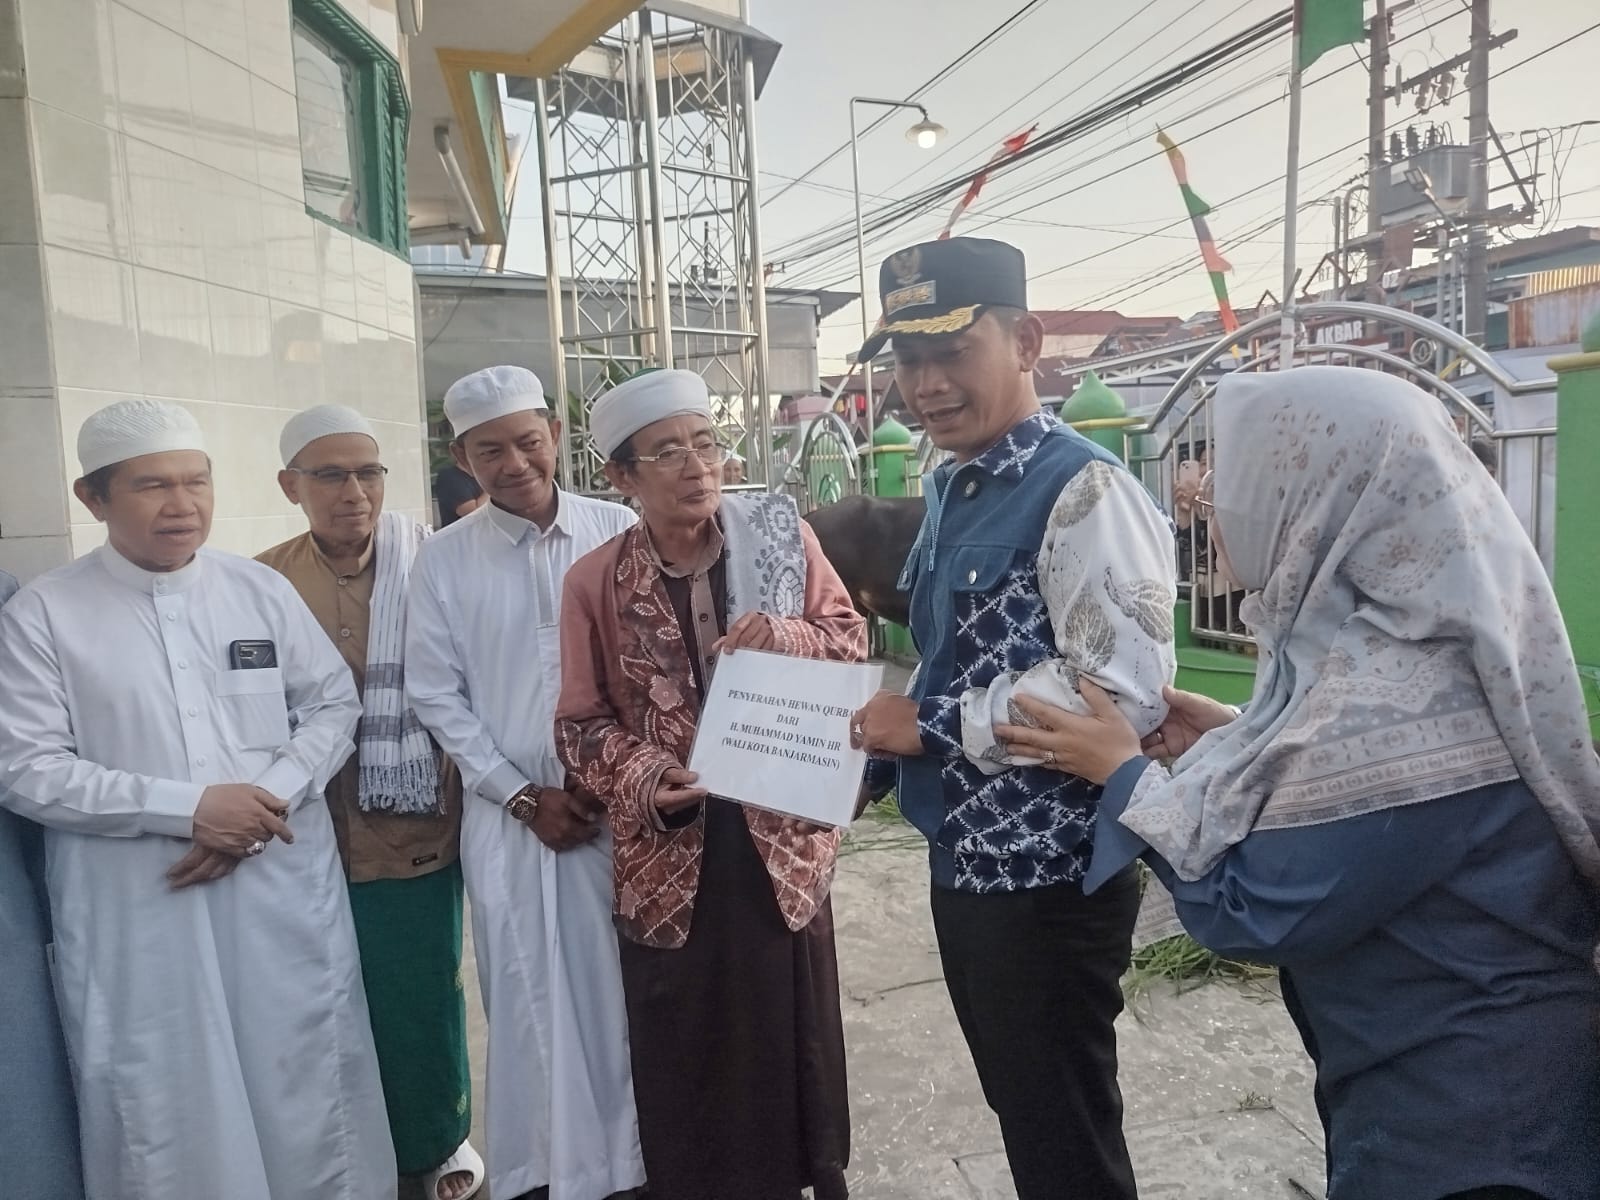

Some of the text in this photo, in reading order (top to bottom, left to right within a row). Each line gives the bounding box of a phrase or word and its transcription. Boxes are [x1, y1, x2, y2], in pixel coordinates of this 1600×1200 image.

[1316, 320, 1363, 345] AKBAR
[728, 689, 787, 707] PENYERAHAN
[788, 699, 821, 713] HEWAN
[776, 713, 800, 726] DARI
[730, 722, 841, 751] H. MUHAMMAD YAMIN HR
[722, 736, 841, 771] (WALI KOTA BANJARMASIN)
